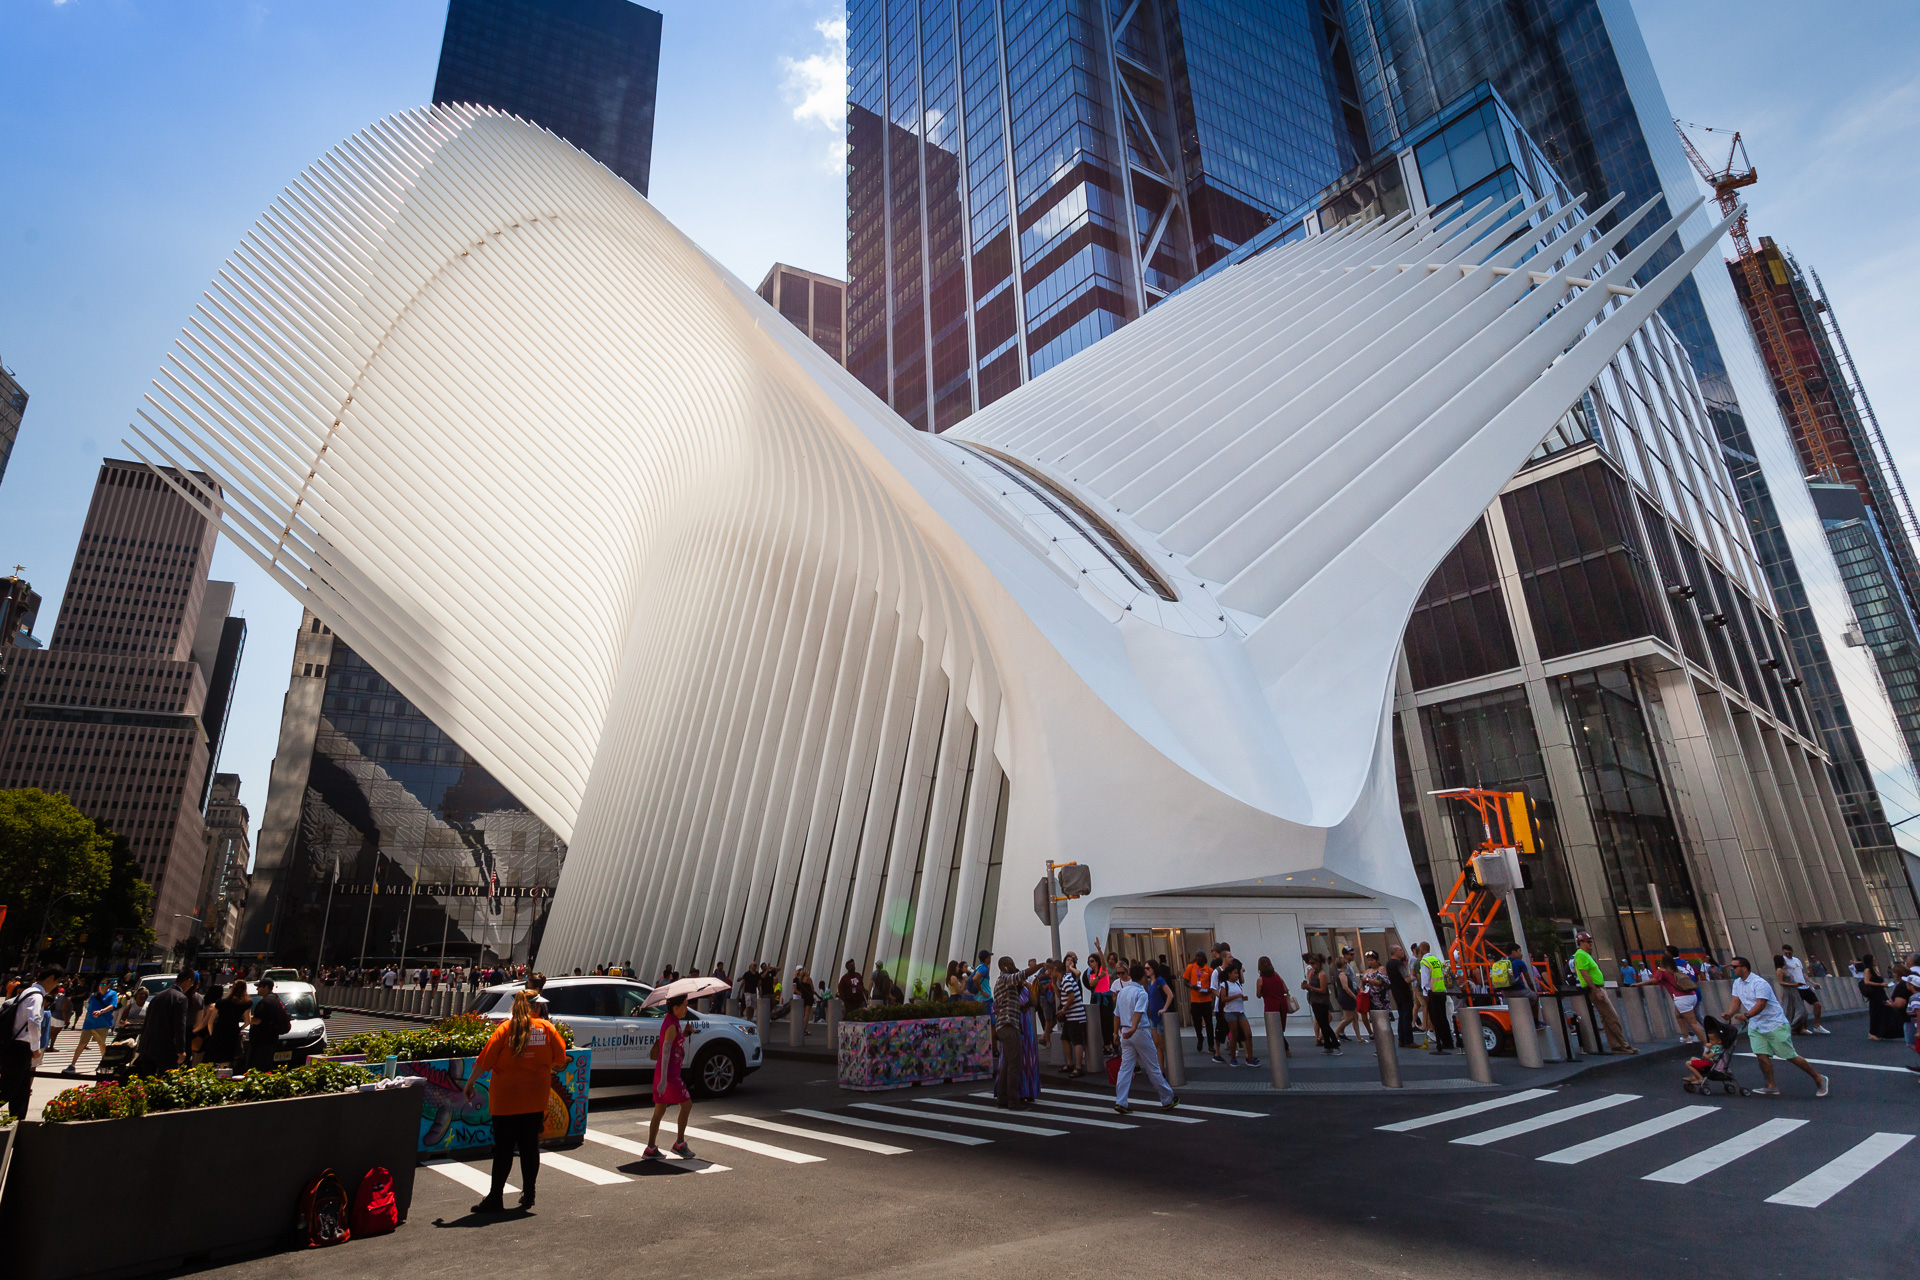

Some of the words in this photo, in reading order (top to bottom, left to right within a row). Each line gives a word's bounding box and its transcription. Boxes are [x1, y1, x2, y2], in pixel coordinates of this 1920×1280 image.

[339, 884, 371, 895] THE
[385, 885, 479, 896] MILLENUM
[492, 887, 550, 898] HILTON
